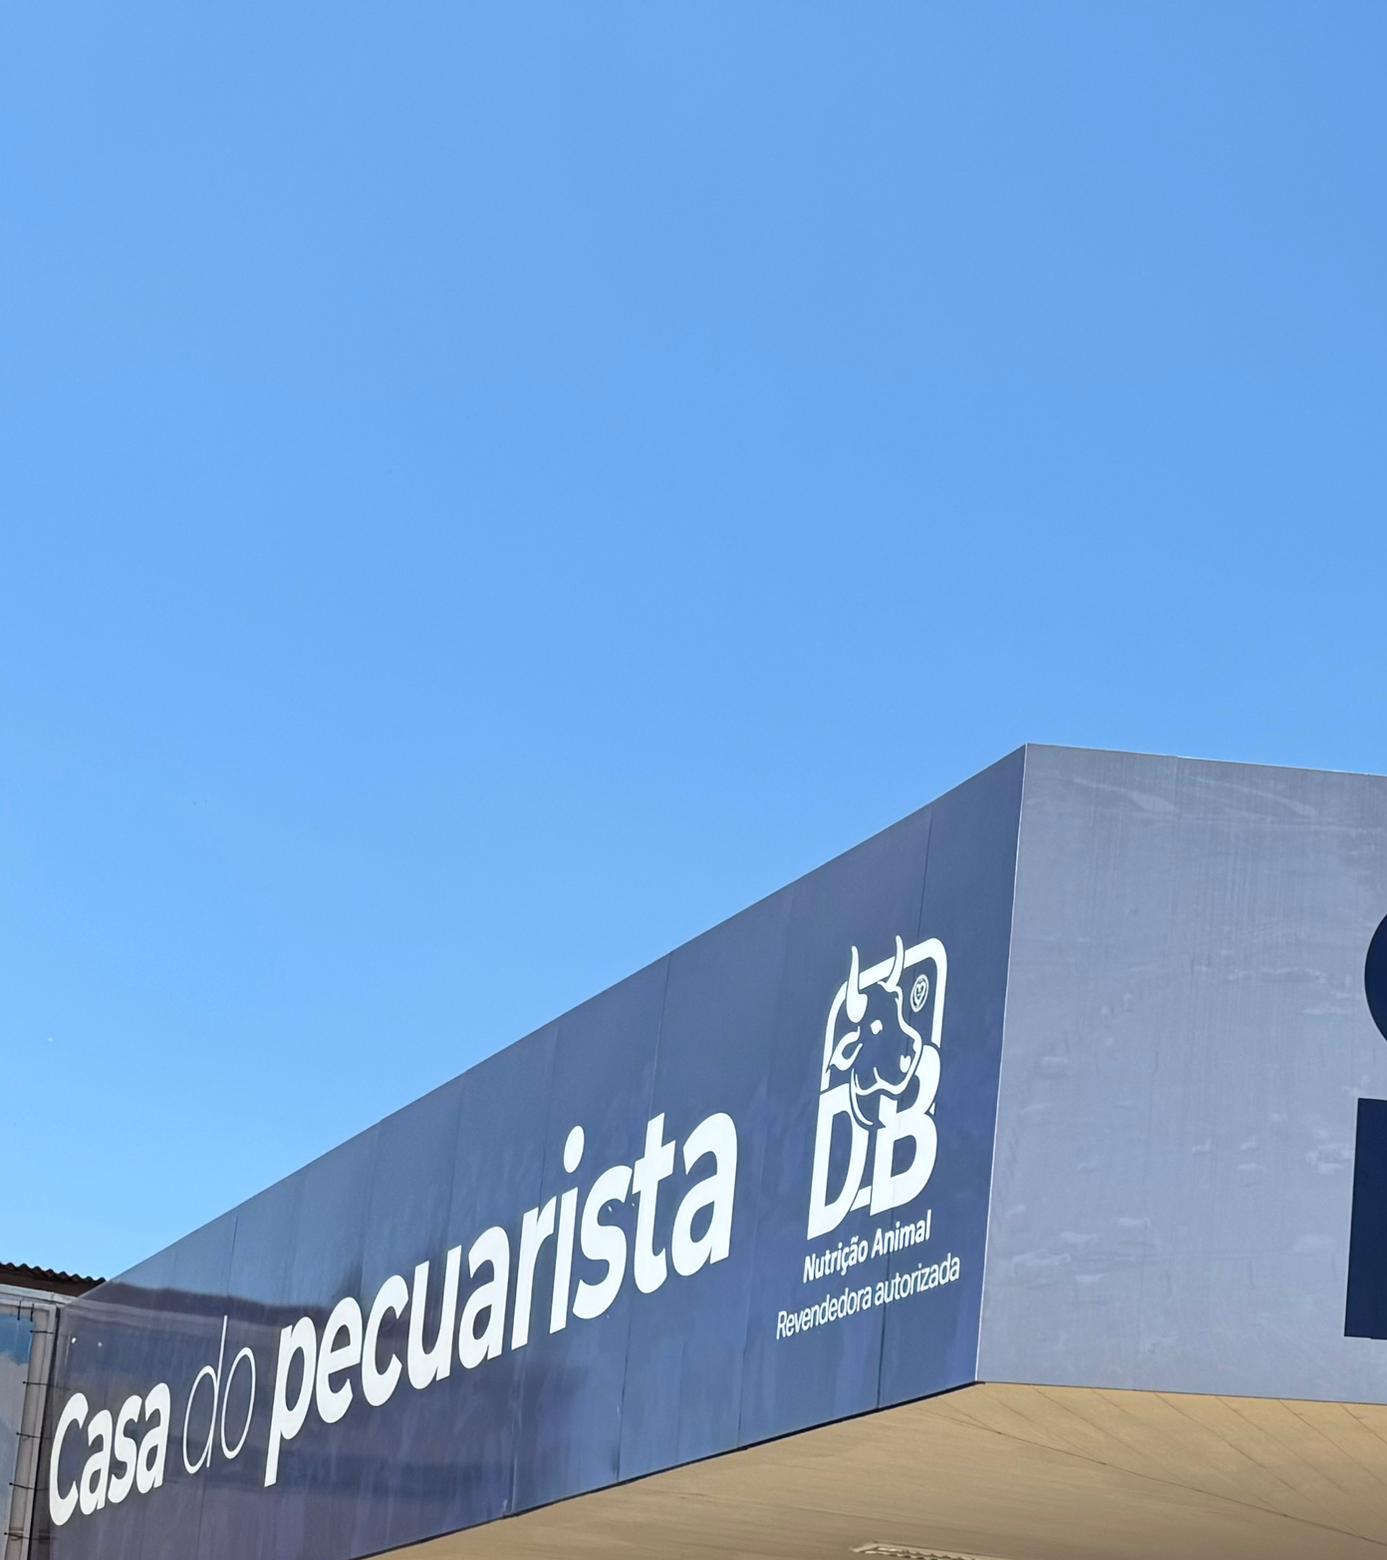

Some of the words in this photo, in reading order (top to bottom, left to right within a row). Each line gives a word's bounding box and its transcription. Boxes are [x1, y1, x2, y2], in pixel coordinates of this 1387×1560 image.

[803, 1235, 869, 1283] Nutrição
[870, 1208, 933, 1259] Animal
[49, 1382, 171, 1526] Casa
[182, 1315, 256, 1474] do
[264, 1111, 739, 1487] pecuarista
[776, 1285, 873, 1340] Revendedora
[873, 1252, 961, 1306] autorizada
